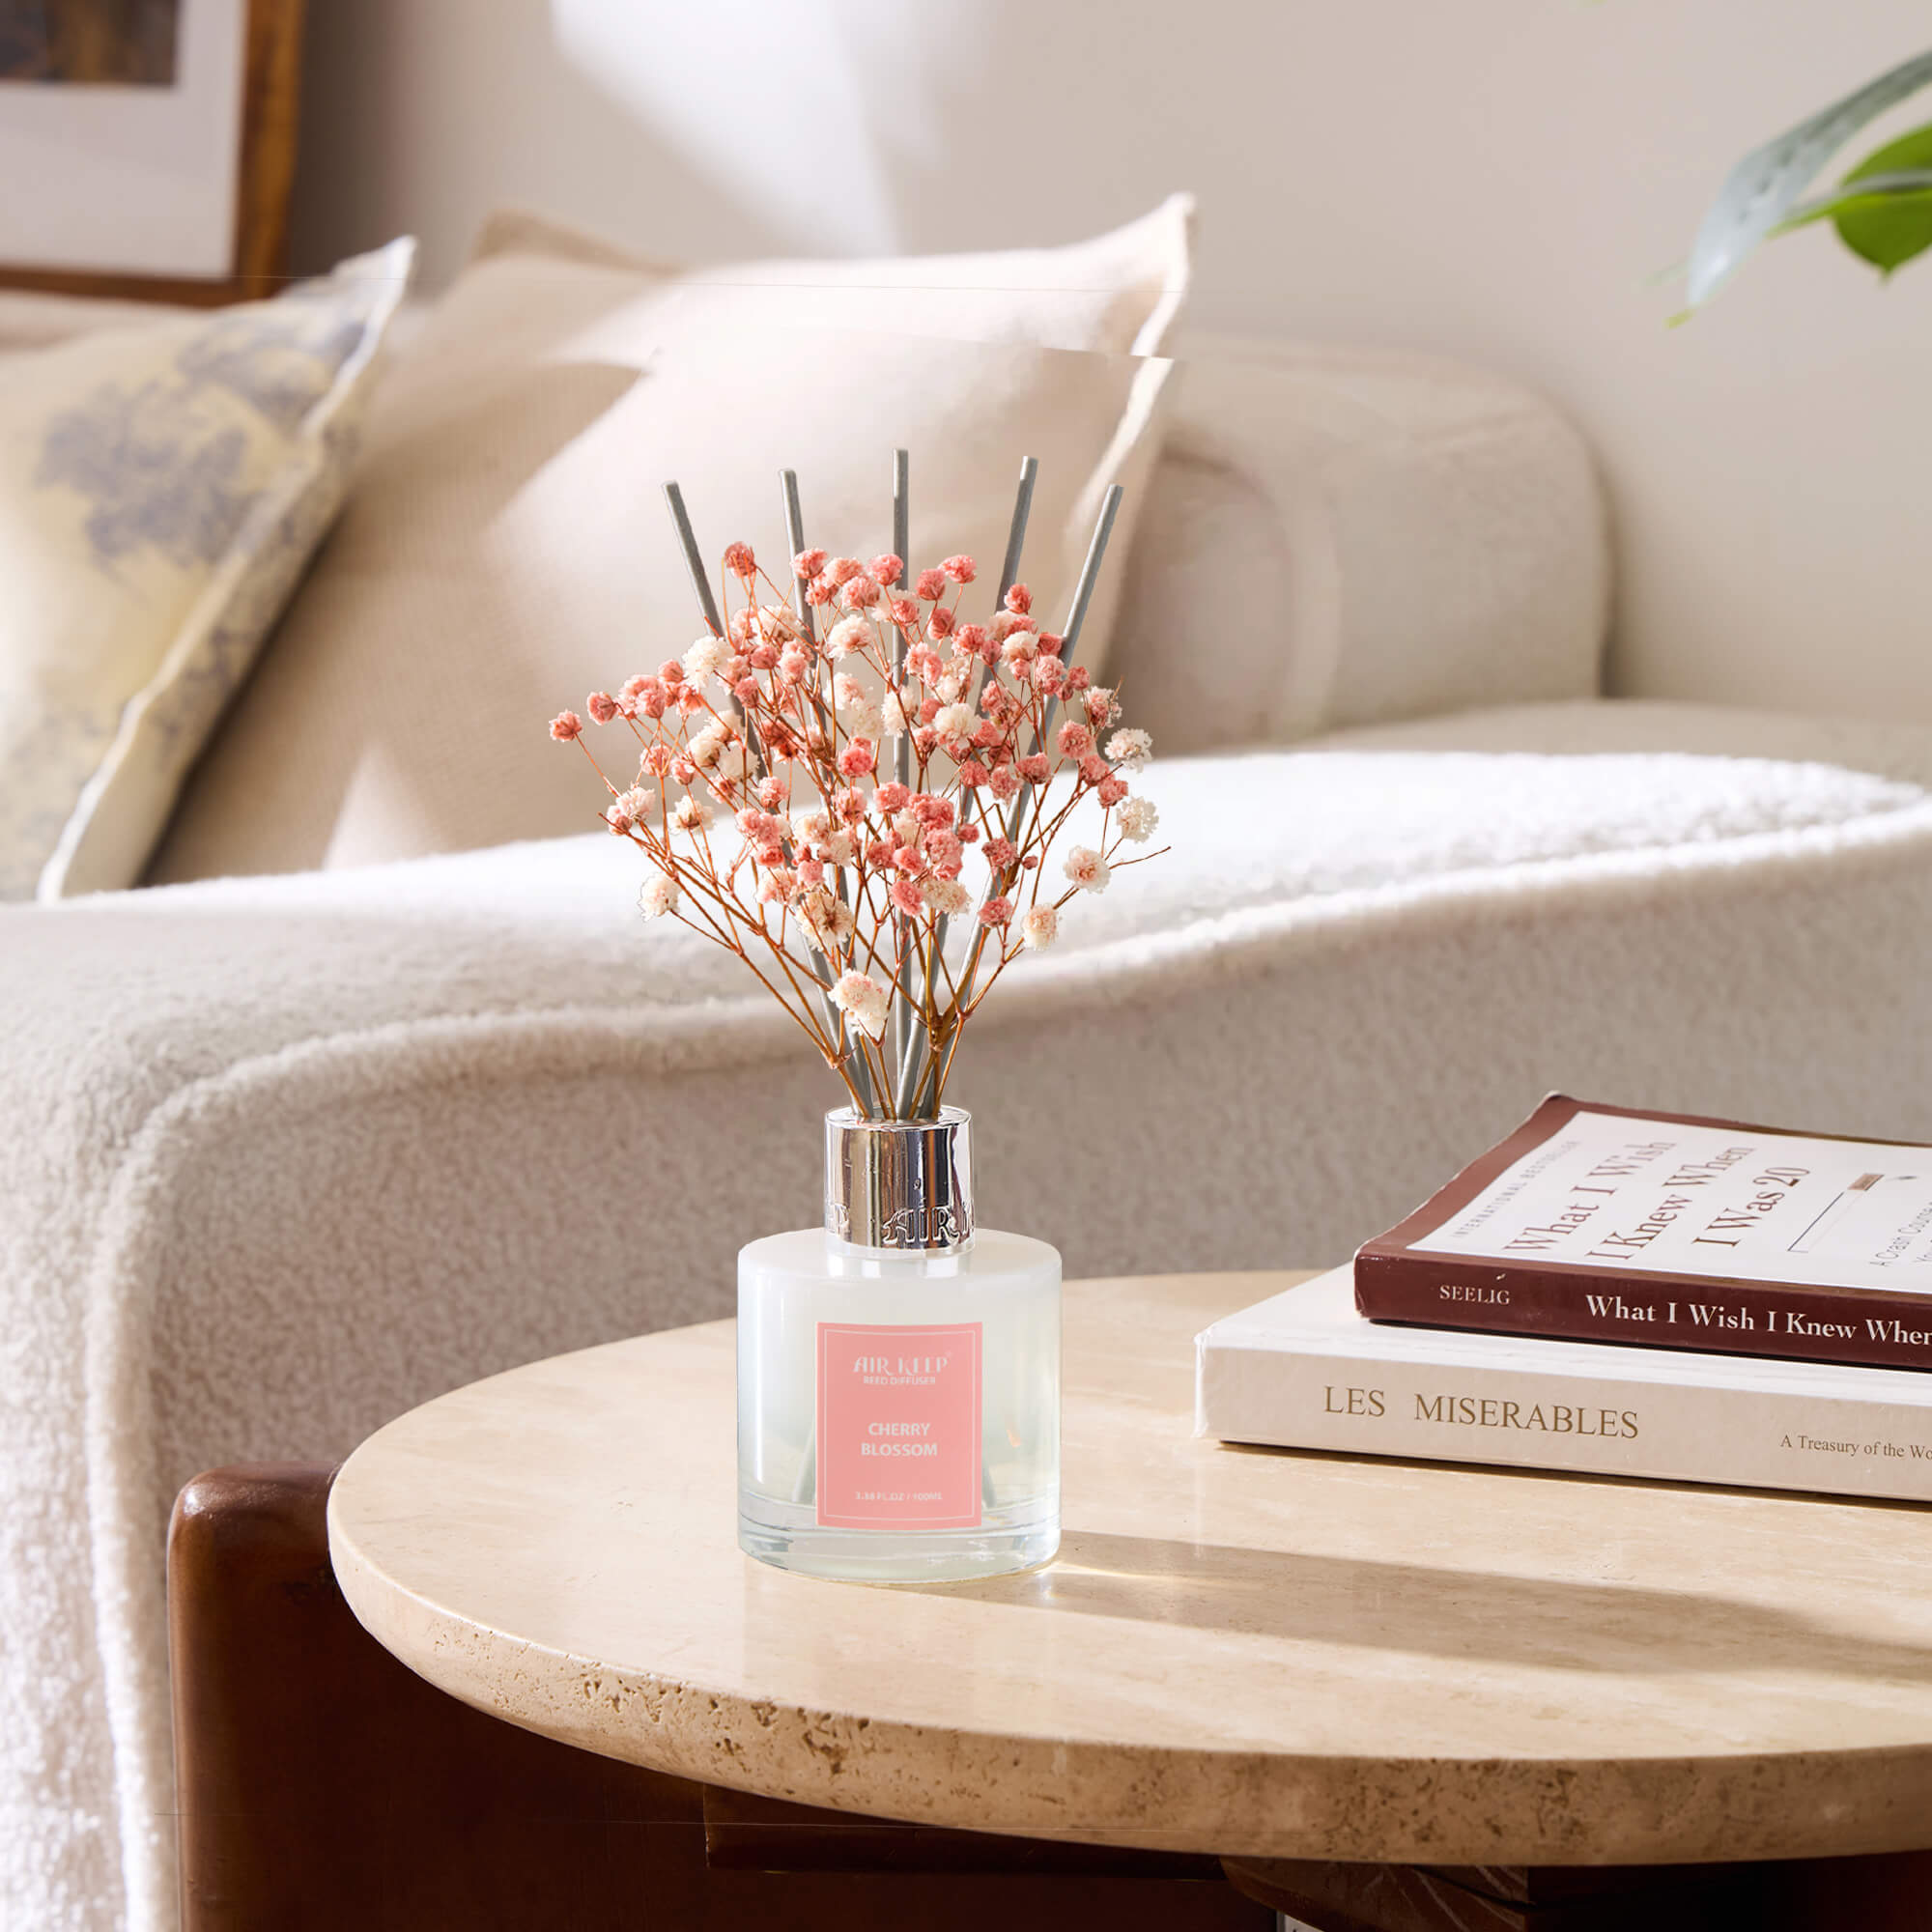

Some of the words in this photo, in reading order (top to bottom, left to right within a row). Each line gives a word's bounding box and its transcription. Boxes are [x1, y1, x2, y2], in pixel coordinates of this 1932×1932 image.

[1585, 1141, 1677, 1177] Wish
[1662, 1146, 1755, 1187] When
[1752, 1166, 1810, 1187] 20
[1570, 1184, 1619, 1197] I
[1599, 1194, 1693, 1249] Knew
[1706, 1190, 1786, 1231] Was
[882, 1206, 960, 1245] AIR
[1501, 1202, 1600, 1250] What
[1691, 1236, 1742, 1247] I
[1584, 1250, 1635, 1261] I
[1438, 1284, 1511, 1305] SEELIG
[1585, 1293, 1657, 1321] What
[1666, 1301, 1678, 1323] I
[1689, 1303, 1755, 1331] Wish
[1767, 1310, 1777, 1332] I
[1785, 1312, 1857, 1340] Knew
[853, 1355, 895, 1377] AIR
[1323, 1385, 1386, 1418] LES
[1413, 1393, 1639, 1439] MISERABLES
[867, 1421, 930, 1437] CHERRY
[860, 1442, 938, 1457] BLOSSOM
[1779, 1434, 1793, 1449] A
[1797, 1435, 1861, 1458] Treasury
[1863, 1440, 1882, 1456] of
[1883, 1442, 1905, 1458] the
